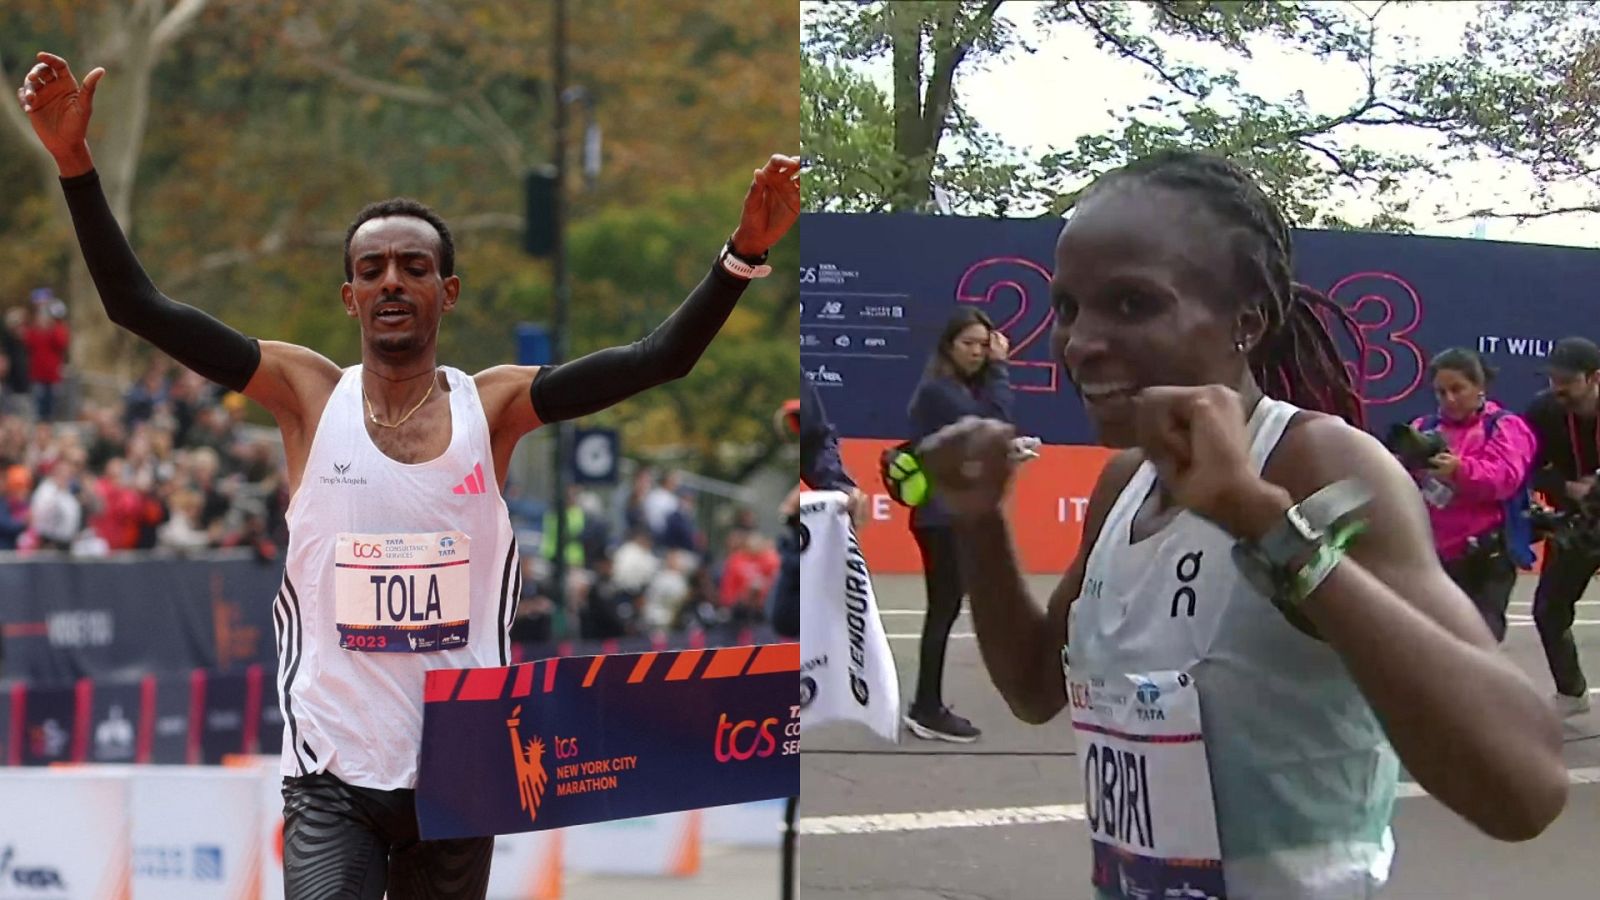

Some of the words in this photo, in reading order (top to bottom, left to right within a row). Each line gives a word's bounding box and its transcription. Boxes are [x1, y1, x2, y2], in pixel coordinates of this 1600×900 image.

[1479, 336, 1500, 353] IT
[576, 434, 614, 478] 6
[370, 574, 442, 622] TOLA
[346, 635, 386, 648] 2023
[1136, 708, 1165, 720] TATA
[554, 736, 578, 759] tcs
[714, 712, 779, 762] tcs
[557, 764, 579, 779] NEW
[581, 760, 610, 775] YORK
[612, 756, 637, 771] CITY
[557, 775, 617, 797] MARATHON
[1084, 742, 1154, 848] OBIRI
